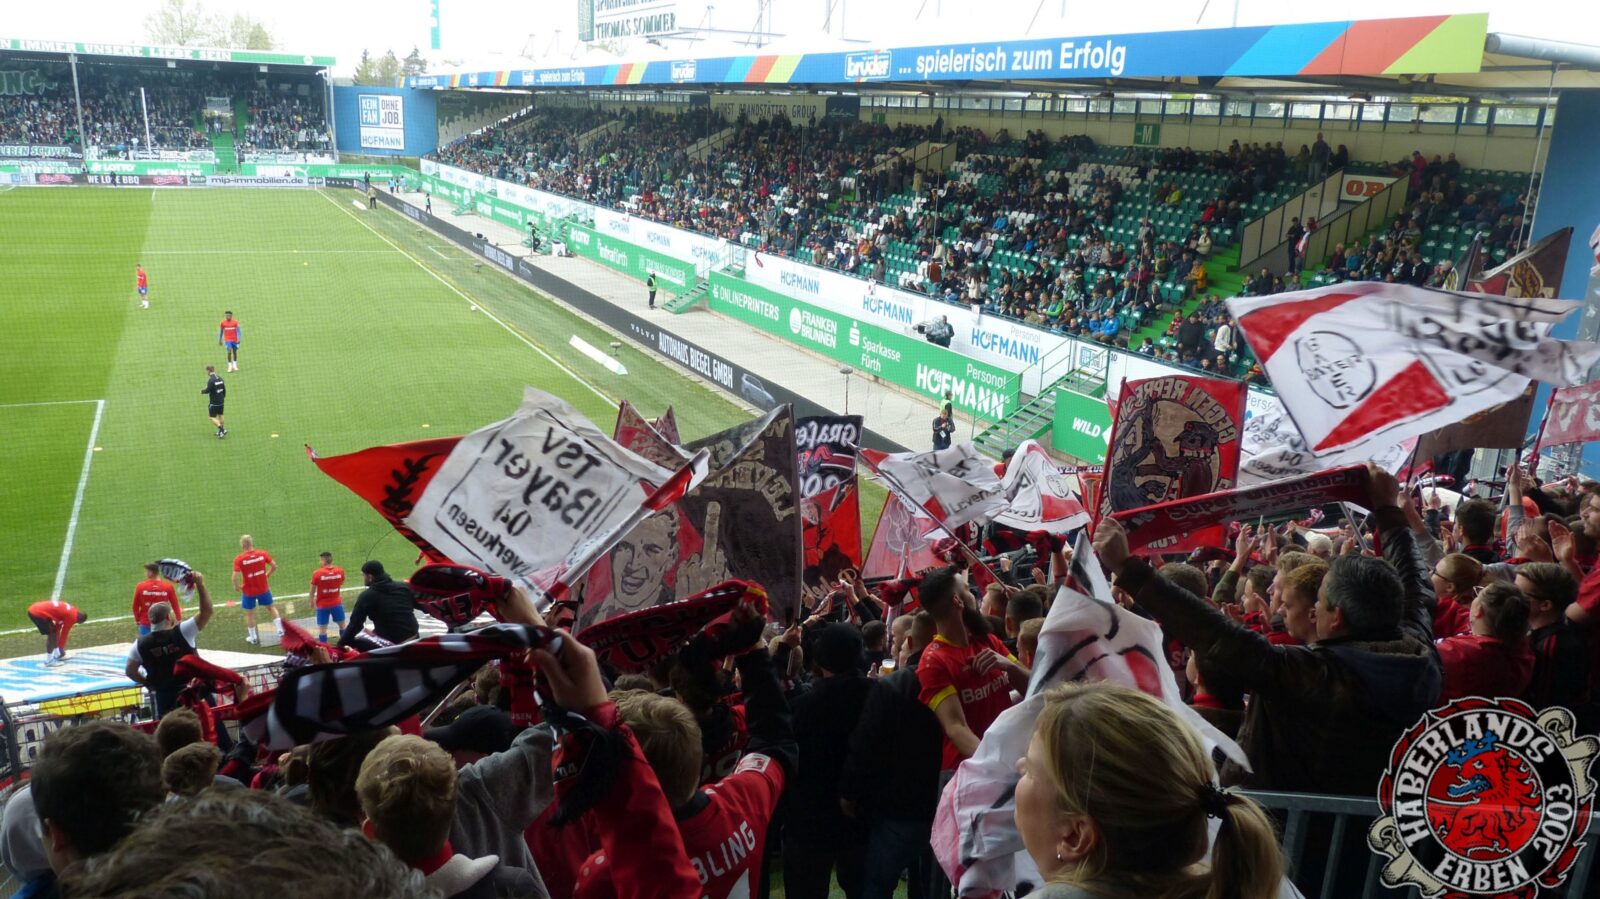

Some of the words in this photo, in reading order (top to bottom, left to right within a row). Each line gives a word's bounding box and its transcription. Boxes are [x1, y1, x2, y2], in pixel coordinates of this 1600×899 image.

[595, 18, 631, 39] THOMAS
[633, 13, 676, 35] SOMMER
[20, 40, 75, 53] IMMER
[83, 43, 143, 57] UNSERE
[150, 47, 193, 59] LIEBE
[199, 50, 232, 61] SEIN
[915, 47, 1002, 79] spielerisch
[1010, 49, 1053, 71] zum
[1059, 40, 1127, 75] Erfolg
[361, 98, 378, 110] KEIN
[381, 98, 400, 110] OHNE
[791, 104, 817, 119] GROUP
[362, 111, 378, 124] FAN
[362, 136, 401, 146] HOFMANN
[87, 175, 99, 184] WE
[101, 175, 121, 184] LOE
[122, 175, 139, 185] BBQ
[211, 176, 304, 185] mip-immobilien.de
[780, 269, 820, 295] HOFMANN
[720, 286, 779, 321] ONLINEPRINTERS
[863, 295, 913, 325] HOFMANN
[630, 323, 655, 341] VOLVO
[802, 310, 837, 334] FRANKEN
[801, 325, 836, 349] BRUNNEN
[971, 327, 1039, 366] HOFMANN
[658, 331, 689, 365] AUTOHAUS
[690, 347, 712, 377] BIEGEL
[712, 359, 733, 389] GMBH
[862, 336, 901, 362] Sparkasse
[861, 353, 881, 373] Fürth
[916, 362, 1005, 420] HOFMANN
[1072, 416, 1101, 438] WILD
